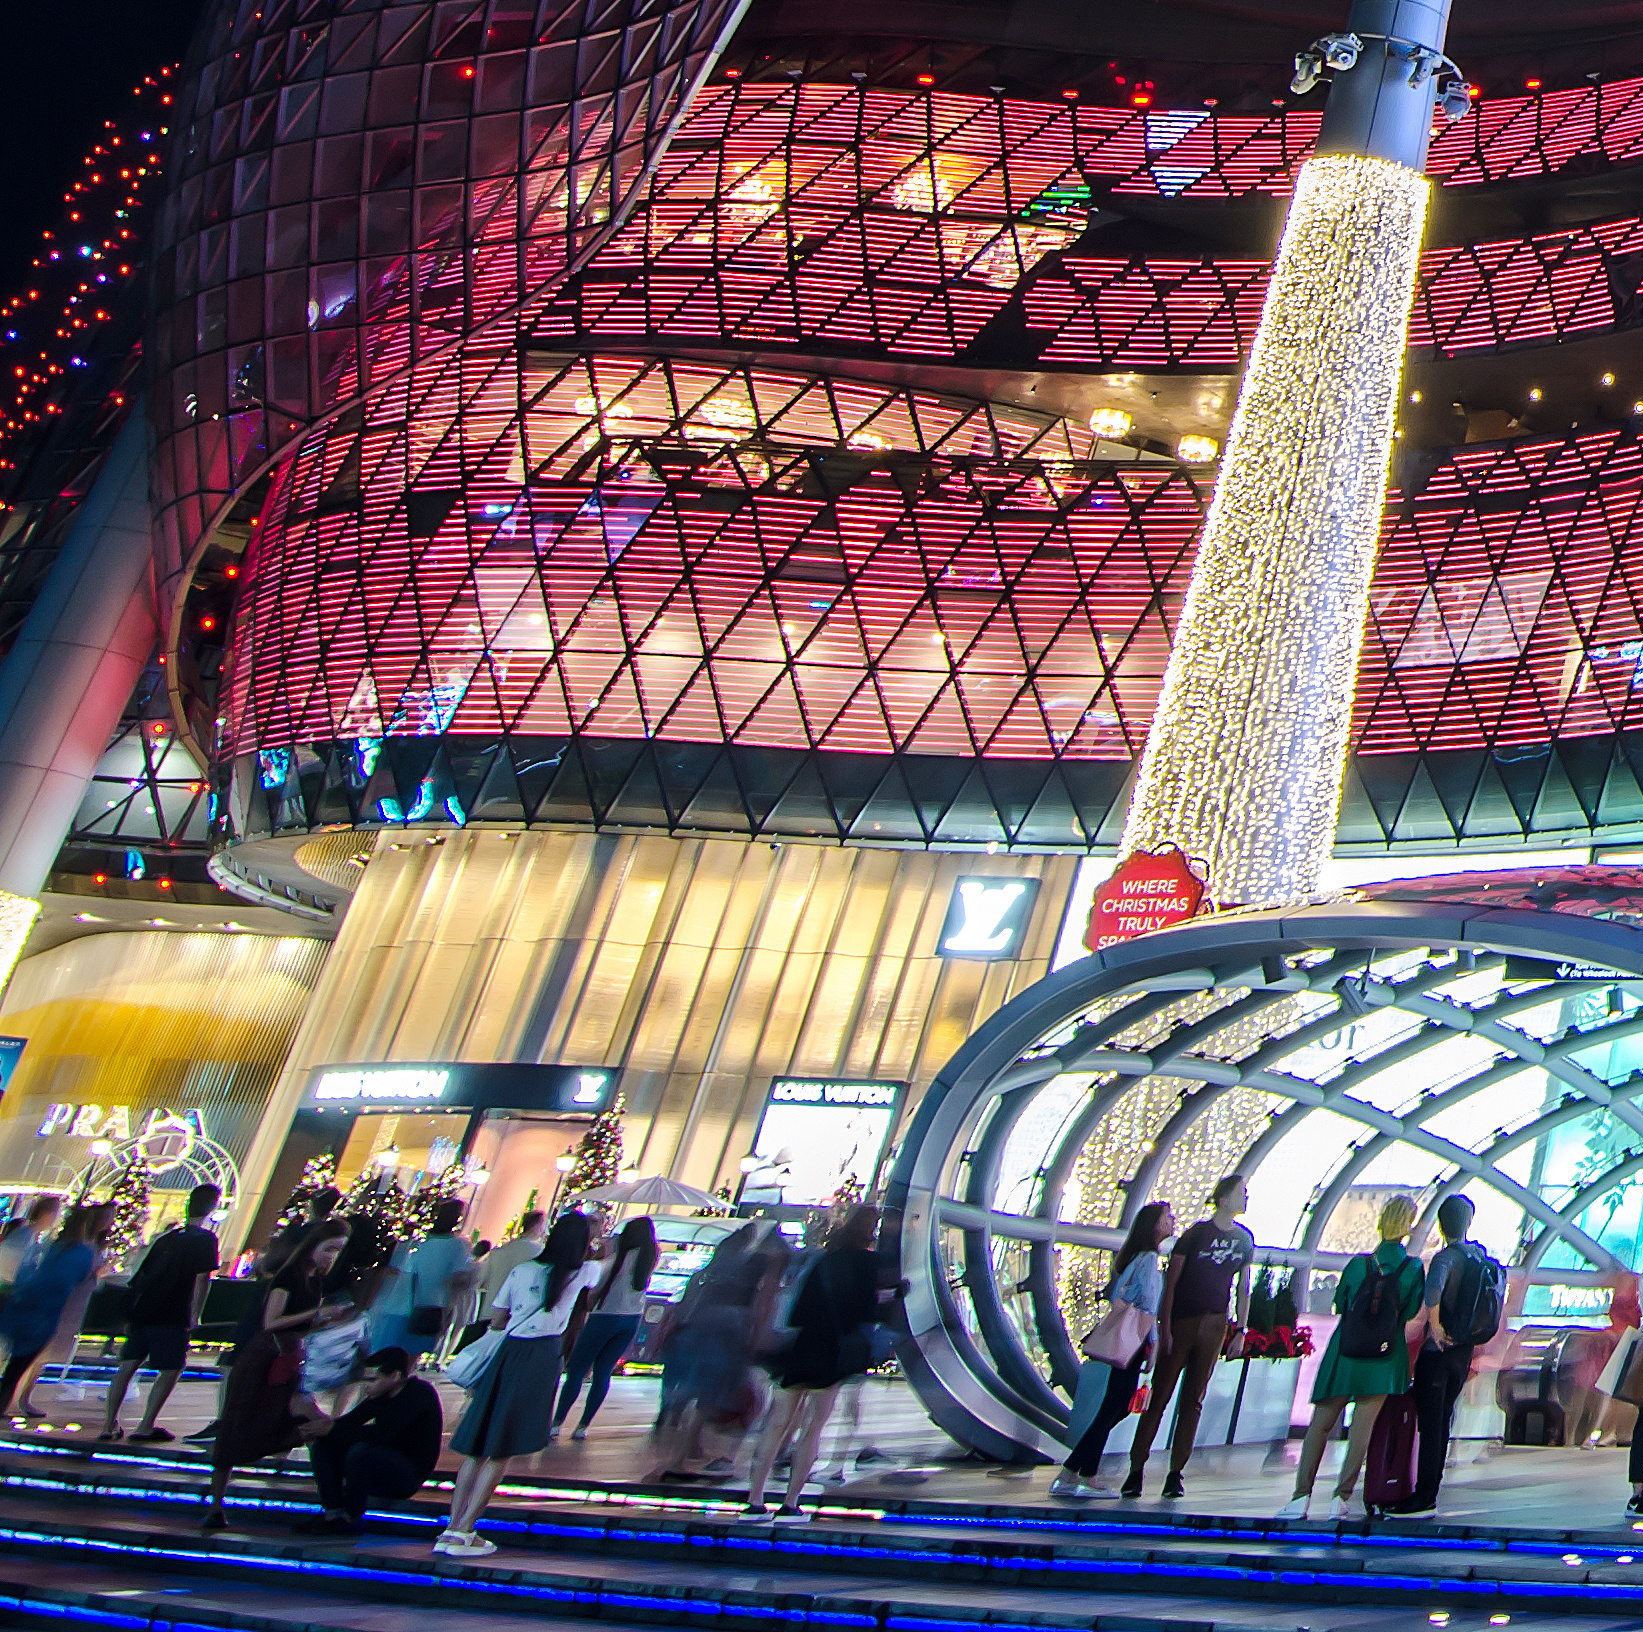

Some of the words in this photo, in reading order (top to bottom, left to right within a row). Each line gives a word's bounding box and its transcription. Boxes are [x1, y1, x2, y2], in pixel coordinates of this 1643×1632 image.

[1122, 879, 1178, 894] WHERE
[1102, 897, 1189, 913] CHRISTMAS
[1117, 916, 1166, 931] TRULY
